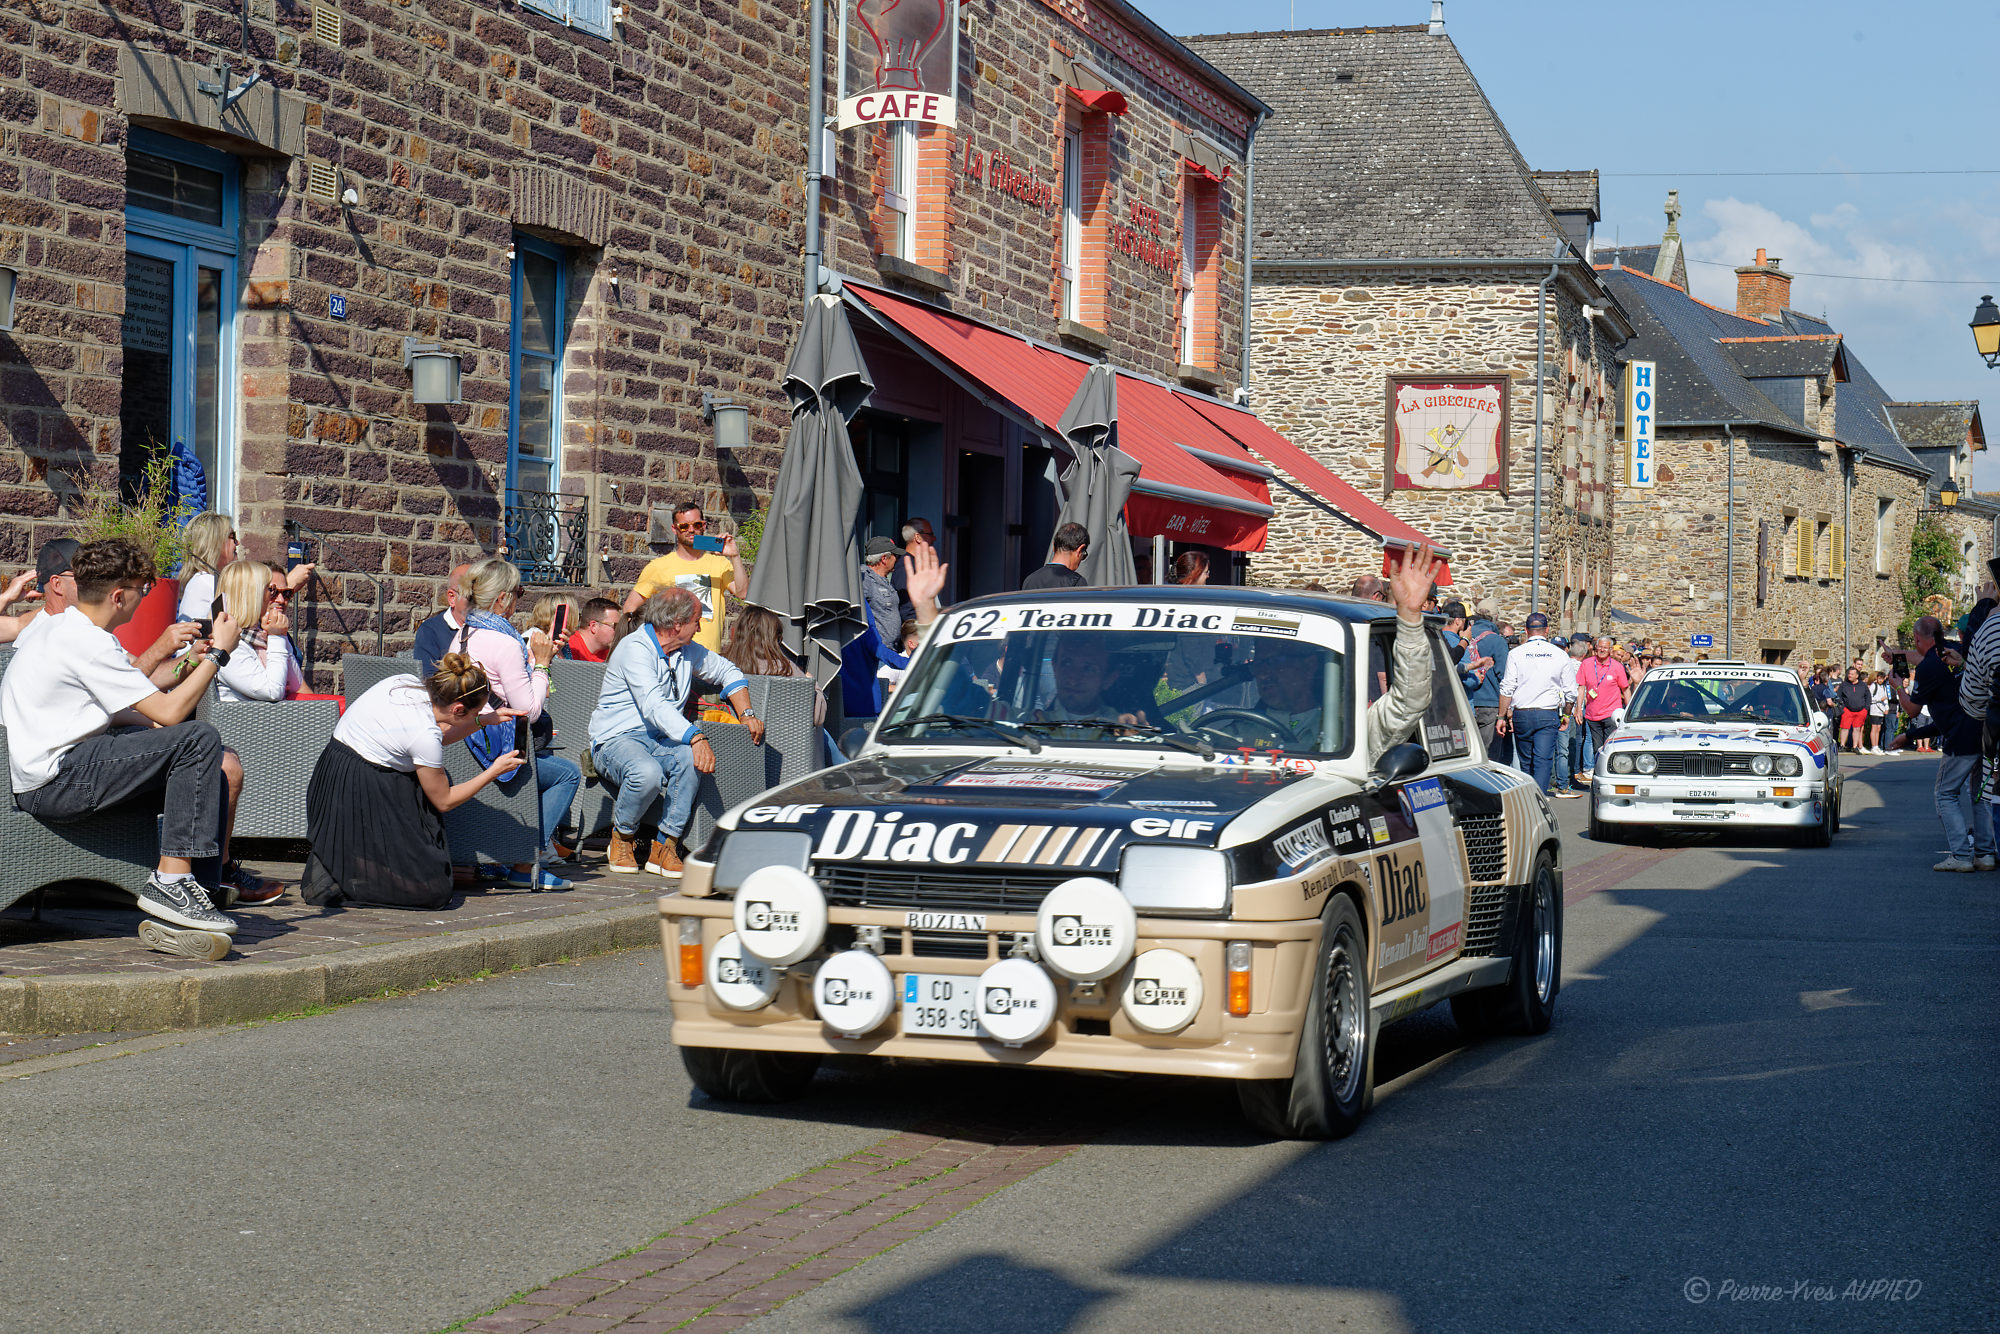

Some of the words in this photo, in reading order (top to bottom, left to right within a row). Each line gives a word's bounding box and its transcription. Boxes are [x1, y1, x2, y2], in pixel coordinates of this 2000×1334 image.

[856, 94, 939, 121] CAFE
[963, 134, 984, 180] La
[989, 149, 1052, 211] Gibecière
[1113, 223, 1176, 275] RESTAURANT
[332, 298, 343, 314] 24
[1401, 400, 1421, 414] LA
[1424, 395, 1496, 414] GIBECIERE
[1635, 366, 1651, 483] HOTEL
[1166, 514, 1187, 532] BAR
[952, 609, 1001, 640] 62
[1018, 608, 1113, 628] Team
[1131, 607, 1222, 630] Diac
[1657, 670, 1675, 680] 74
[1407, 785, 1445, 809] Rothmans
[743, 803, 824, 824] elf
[810, 809, 979, 865] Diac
[1130, 817, 1215, 840] elf
[1276, 822, 1327, 866] MICHELIN
[1301, 866, 1340, 901] Renault
[1376, 852, 1426, 927] Diac
[908, 913, 985, 930] BOZIAN
[932, 980, 953, 1001] CD
